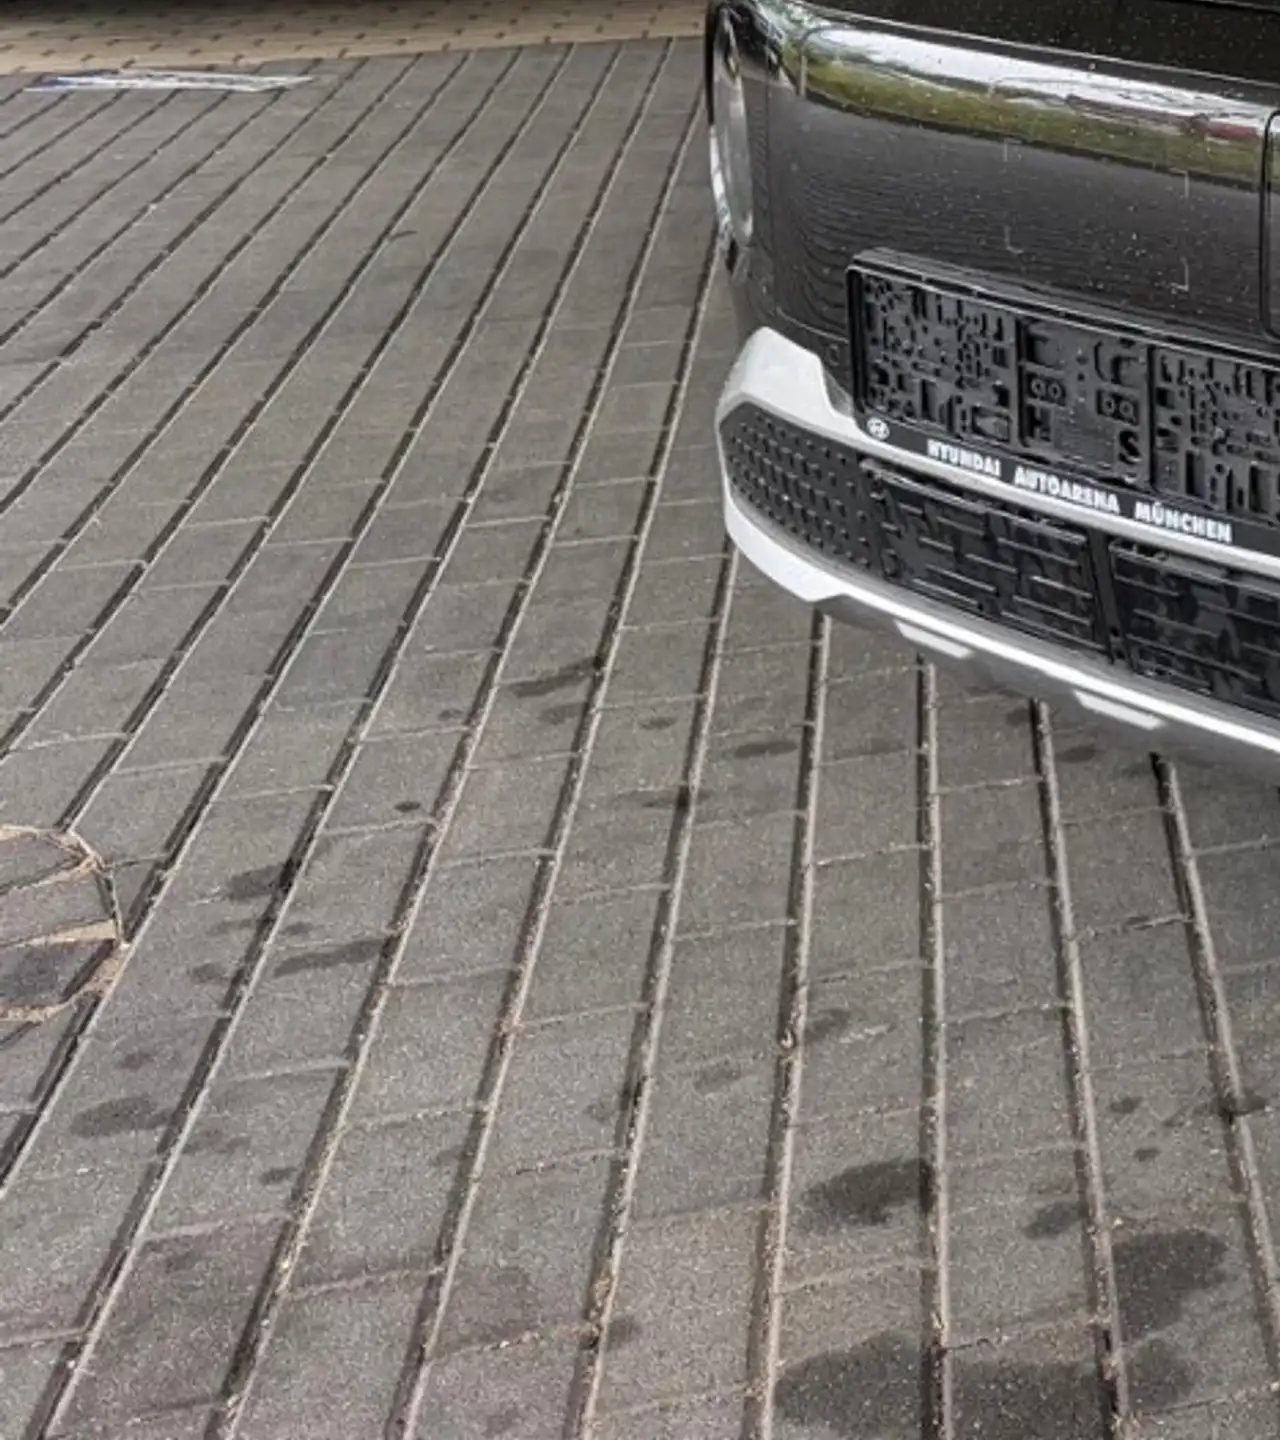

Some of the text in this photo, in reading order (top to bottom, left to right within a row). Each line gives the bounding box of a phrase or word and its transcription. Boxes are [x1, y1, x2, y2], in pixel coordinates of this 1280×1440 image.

[926, 438, 1234, 545] HYUNDAI AUTOARENA MÜNCHEN
